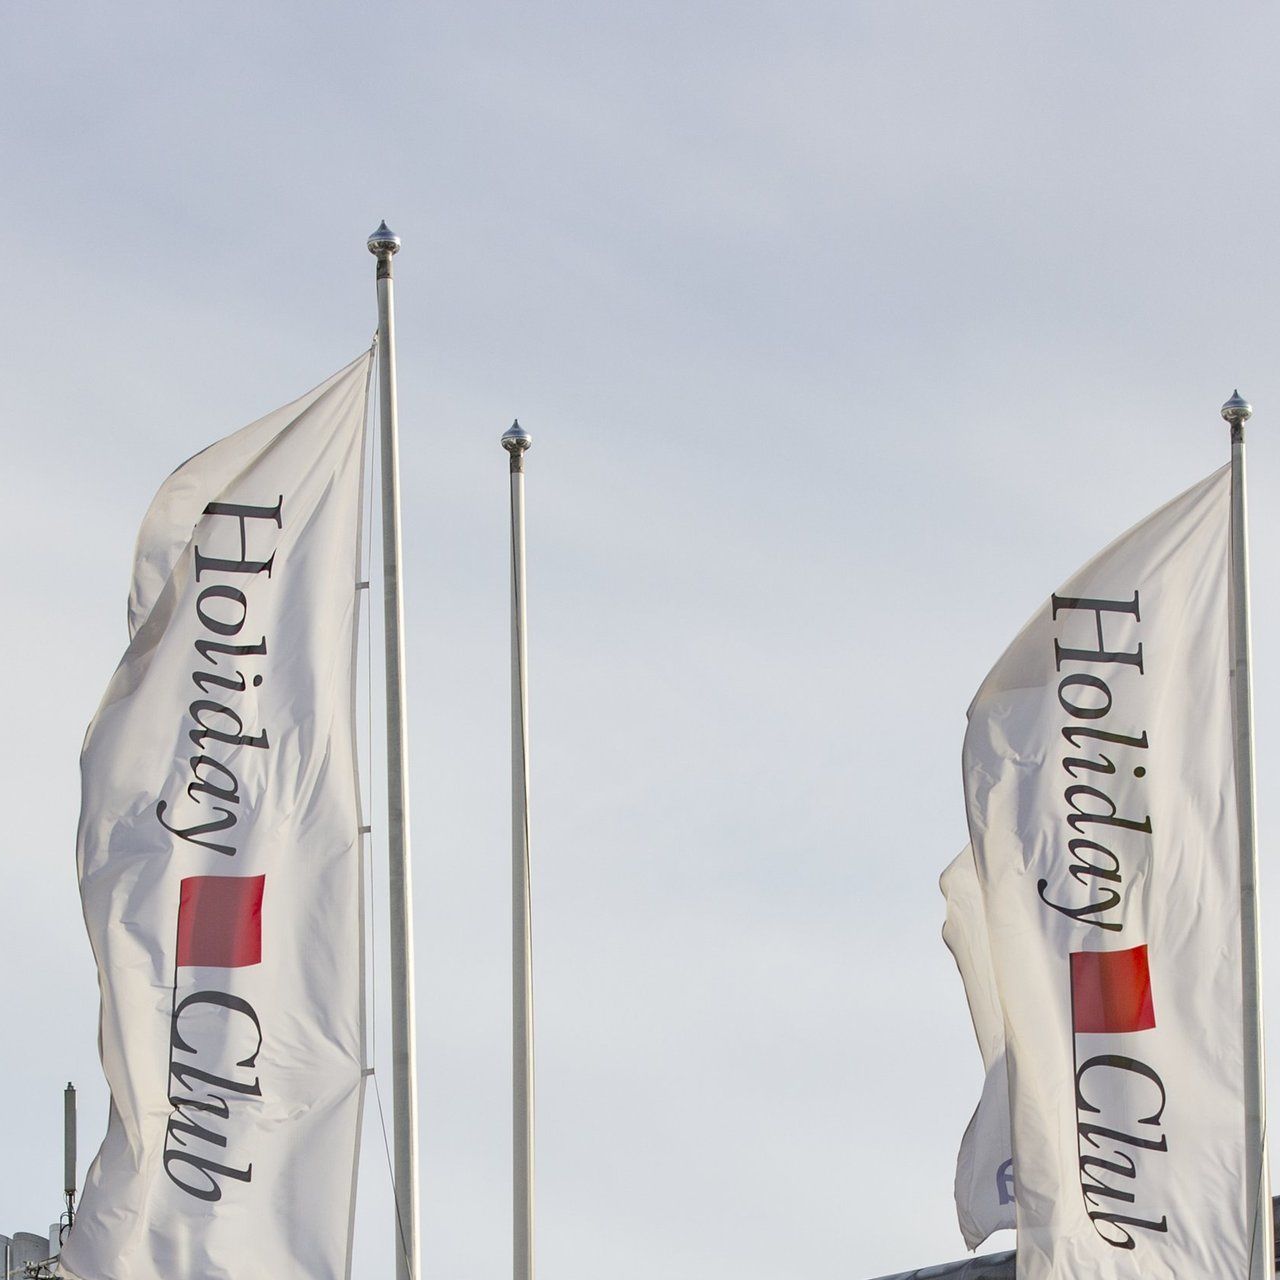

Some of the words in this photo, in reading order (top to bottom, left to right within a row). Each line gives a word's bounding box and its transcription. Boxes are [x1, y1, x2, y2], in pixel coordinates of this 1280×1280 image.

[156, 494, 284, 857] Holiday
[1037, 589, 1153, 933] Holiday
[162, 991, 263, 1202] Club
[1074, 1056, 1168, 1251] Club
